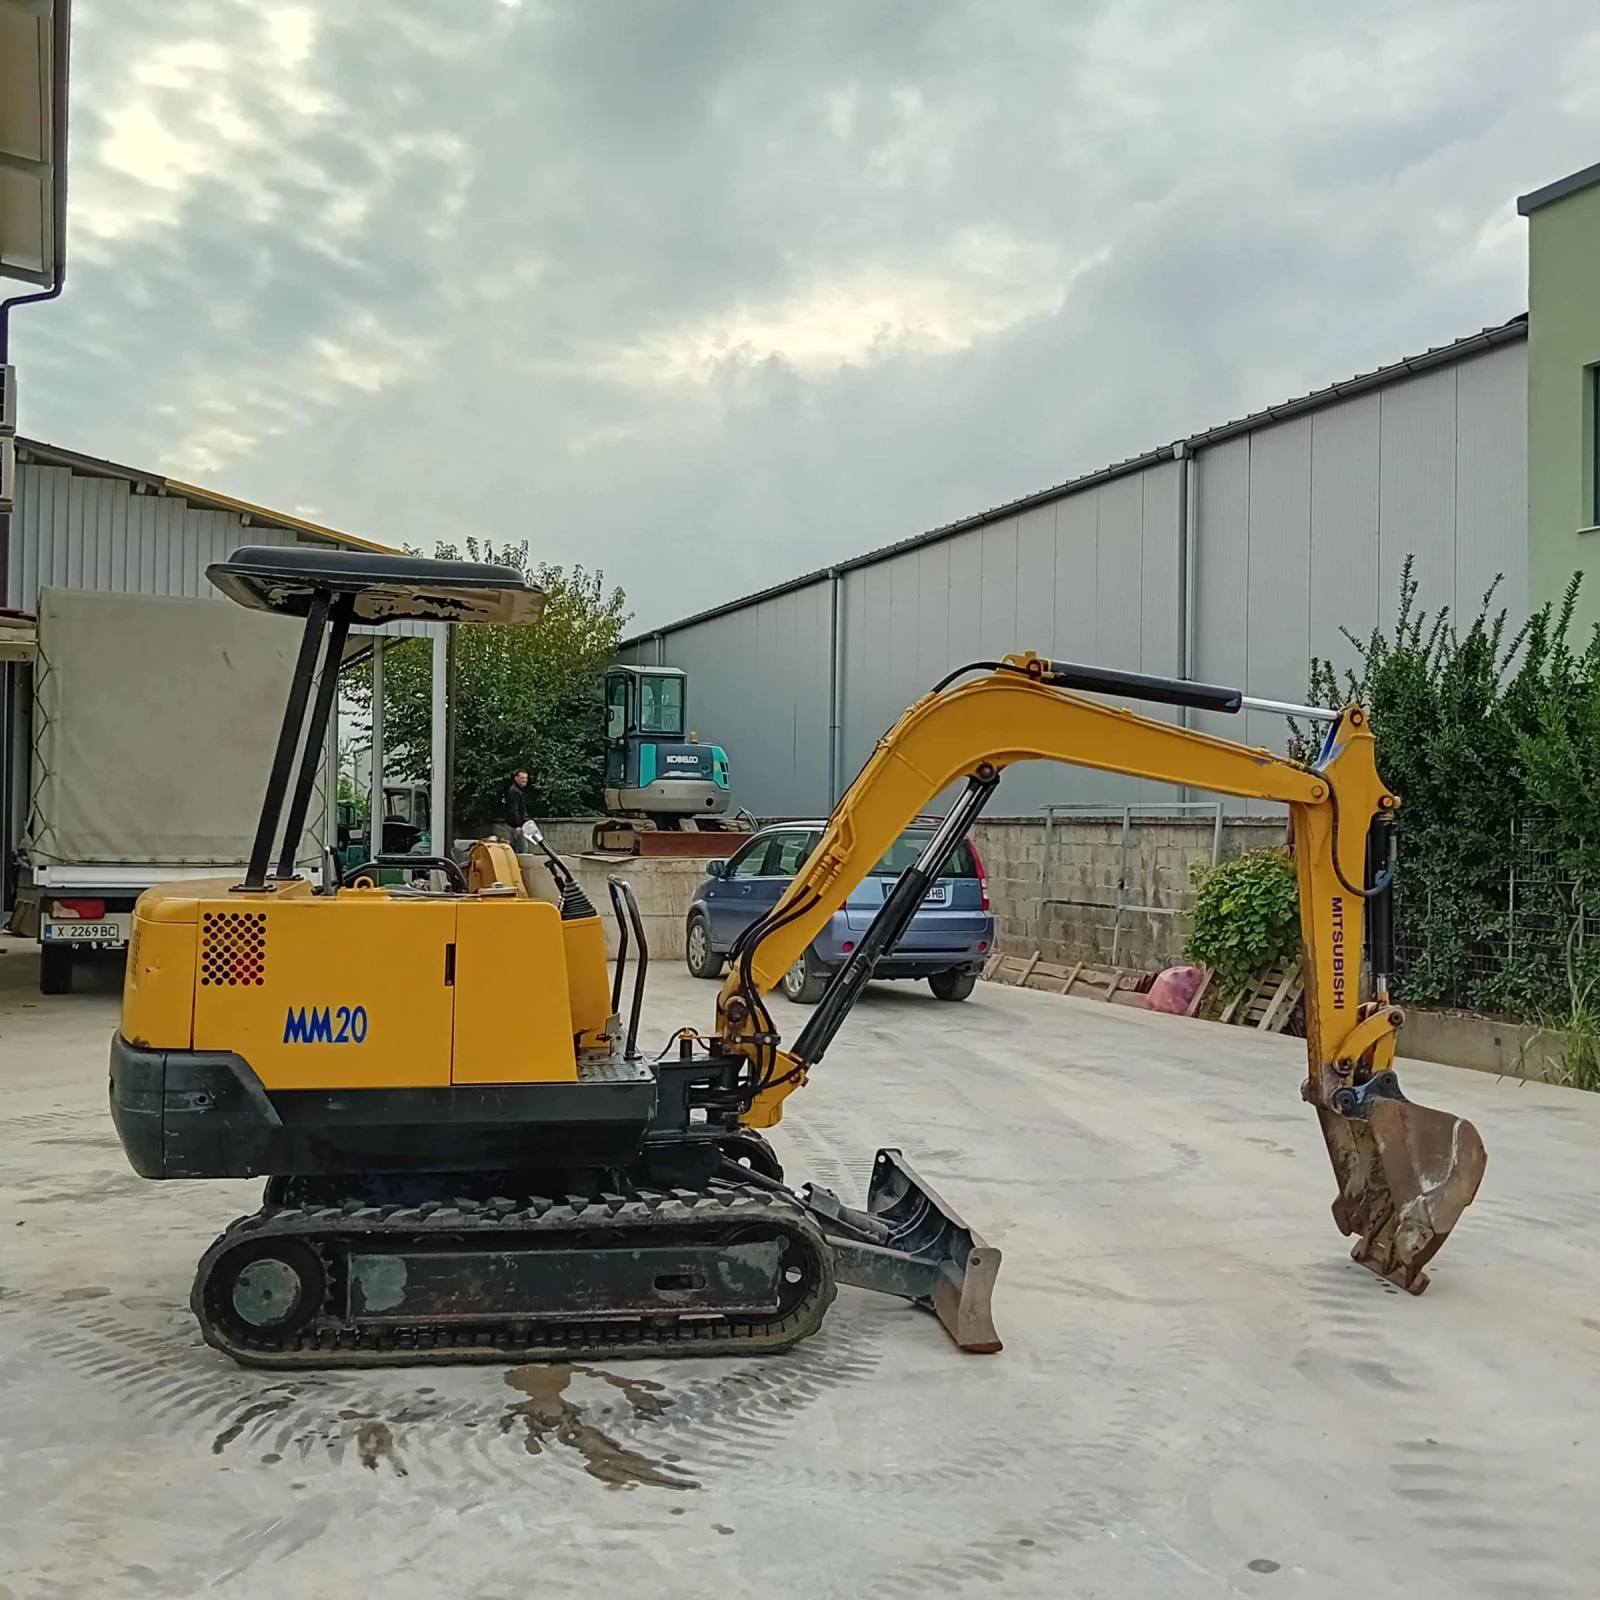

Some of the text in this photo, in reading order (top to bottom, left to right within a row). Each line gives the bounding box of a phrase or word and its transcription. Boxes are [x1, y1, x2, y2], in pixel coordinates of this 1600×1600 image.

[666, 755, 699, 764] KOBELCO
[57, 926, 116, 937] X 2269 BC
[1332, 897, 1345, 1010] MITSUBISHI
[283, 1005, 368, 1044] MM20
